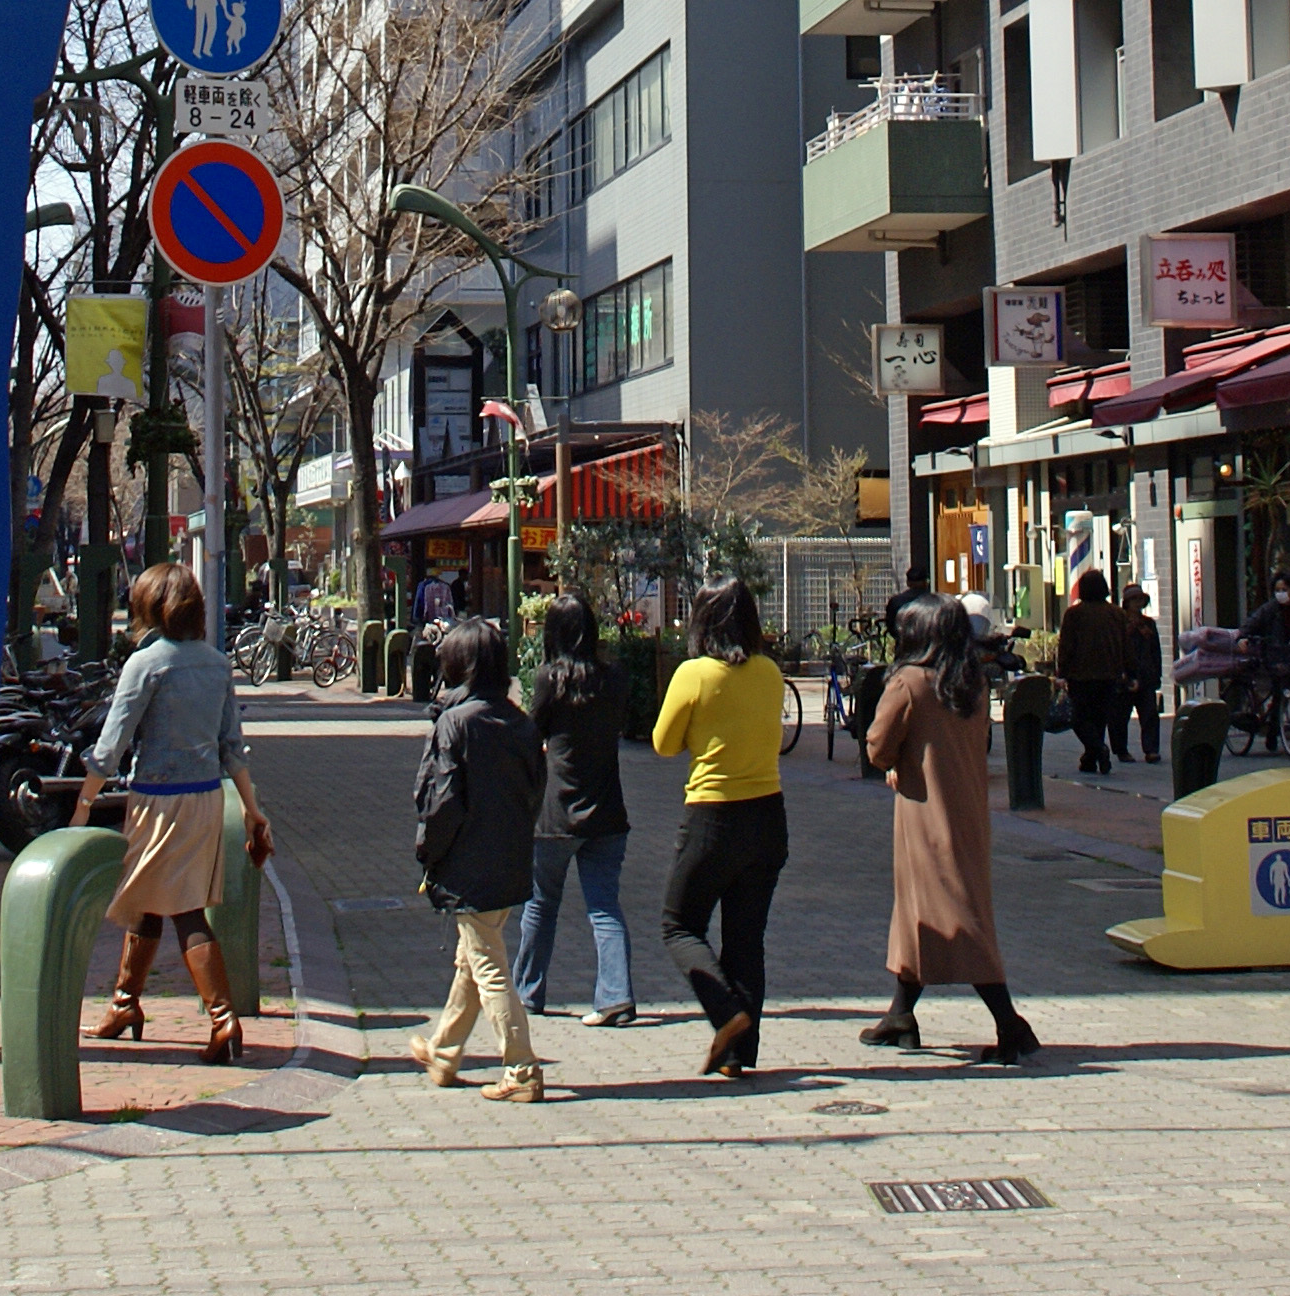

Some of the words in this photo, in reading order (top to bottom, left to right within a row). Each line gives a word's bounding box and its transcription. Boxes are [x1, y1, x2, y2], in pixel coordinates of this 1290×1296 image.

[184, 84, 261, 108] 軽車両を除く
[1155, 257, 1227, 282] 立呑み処
[1177, 290, 1225, 305] ちょっと
[885, 350, 937, 365] 一心
